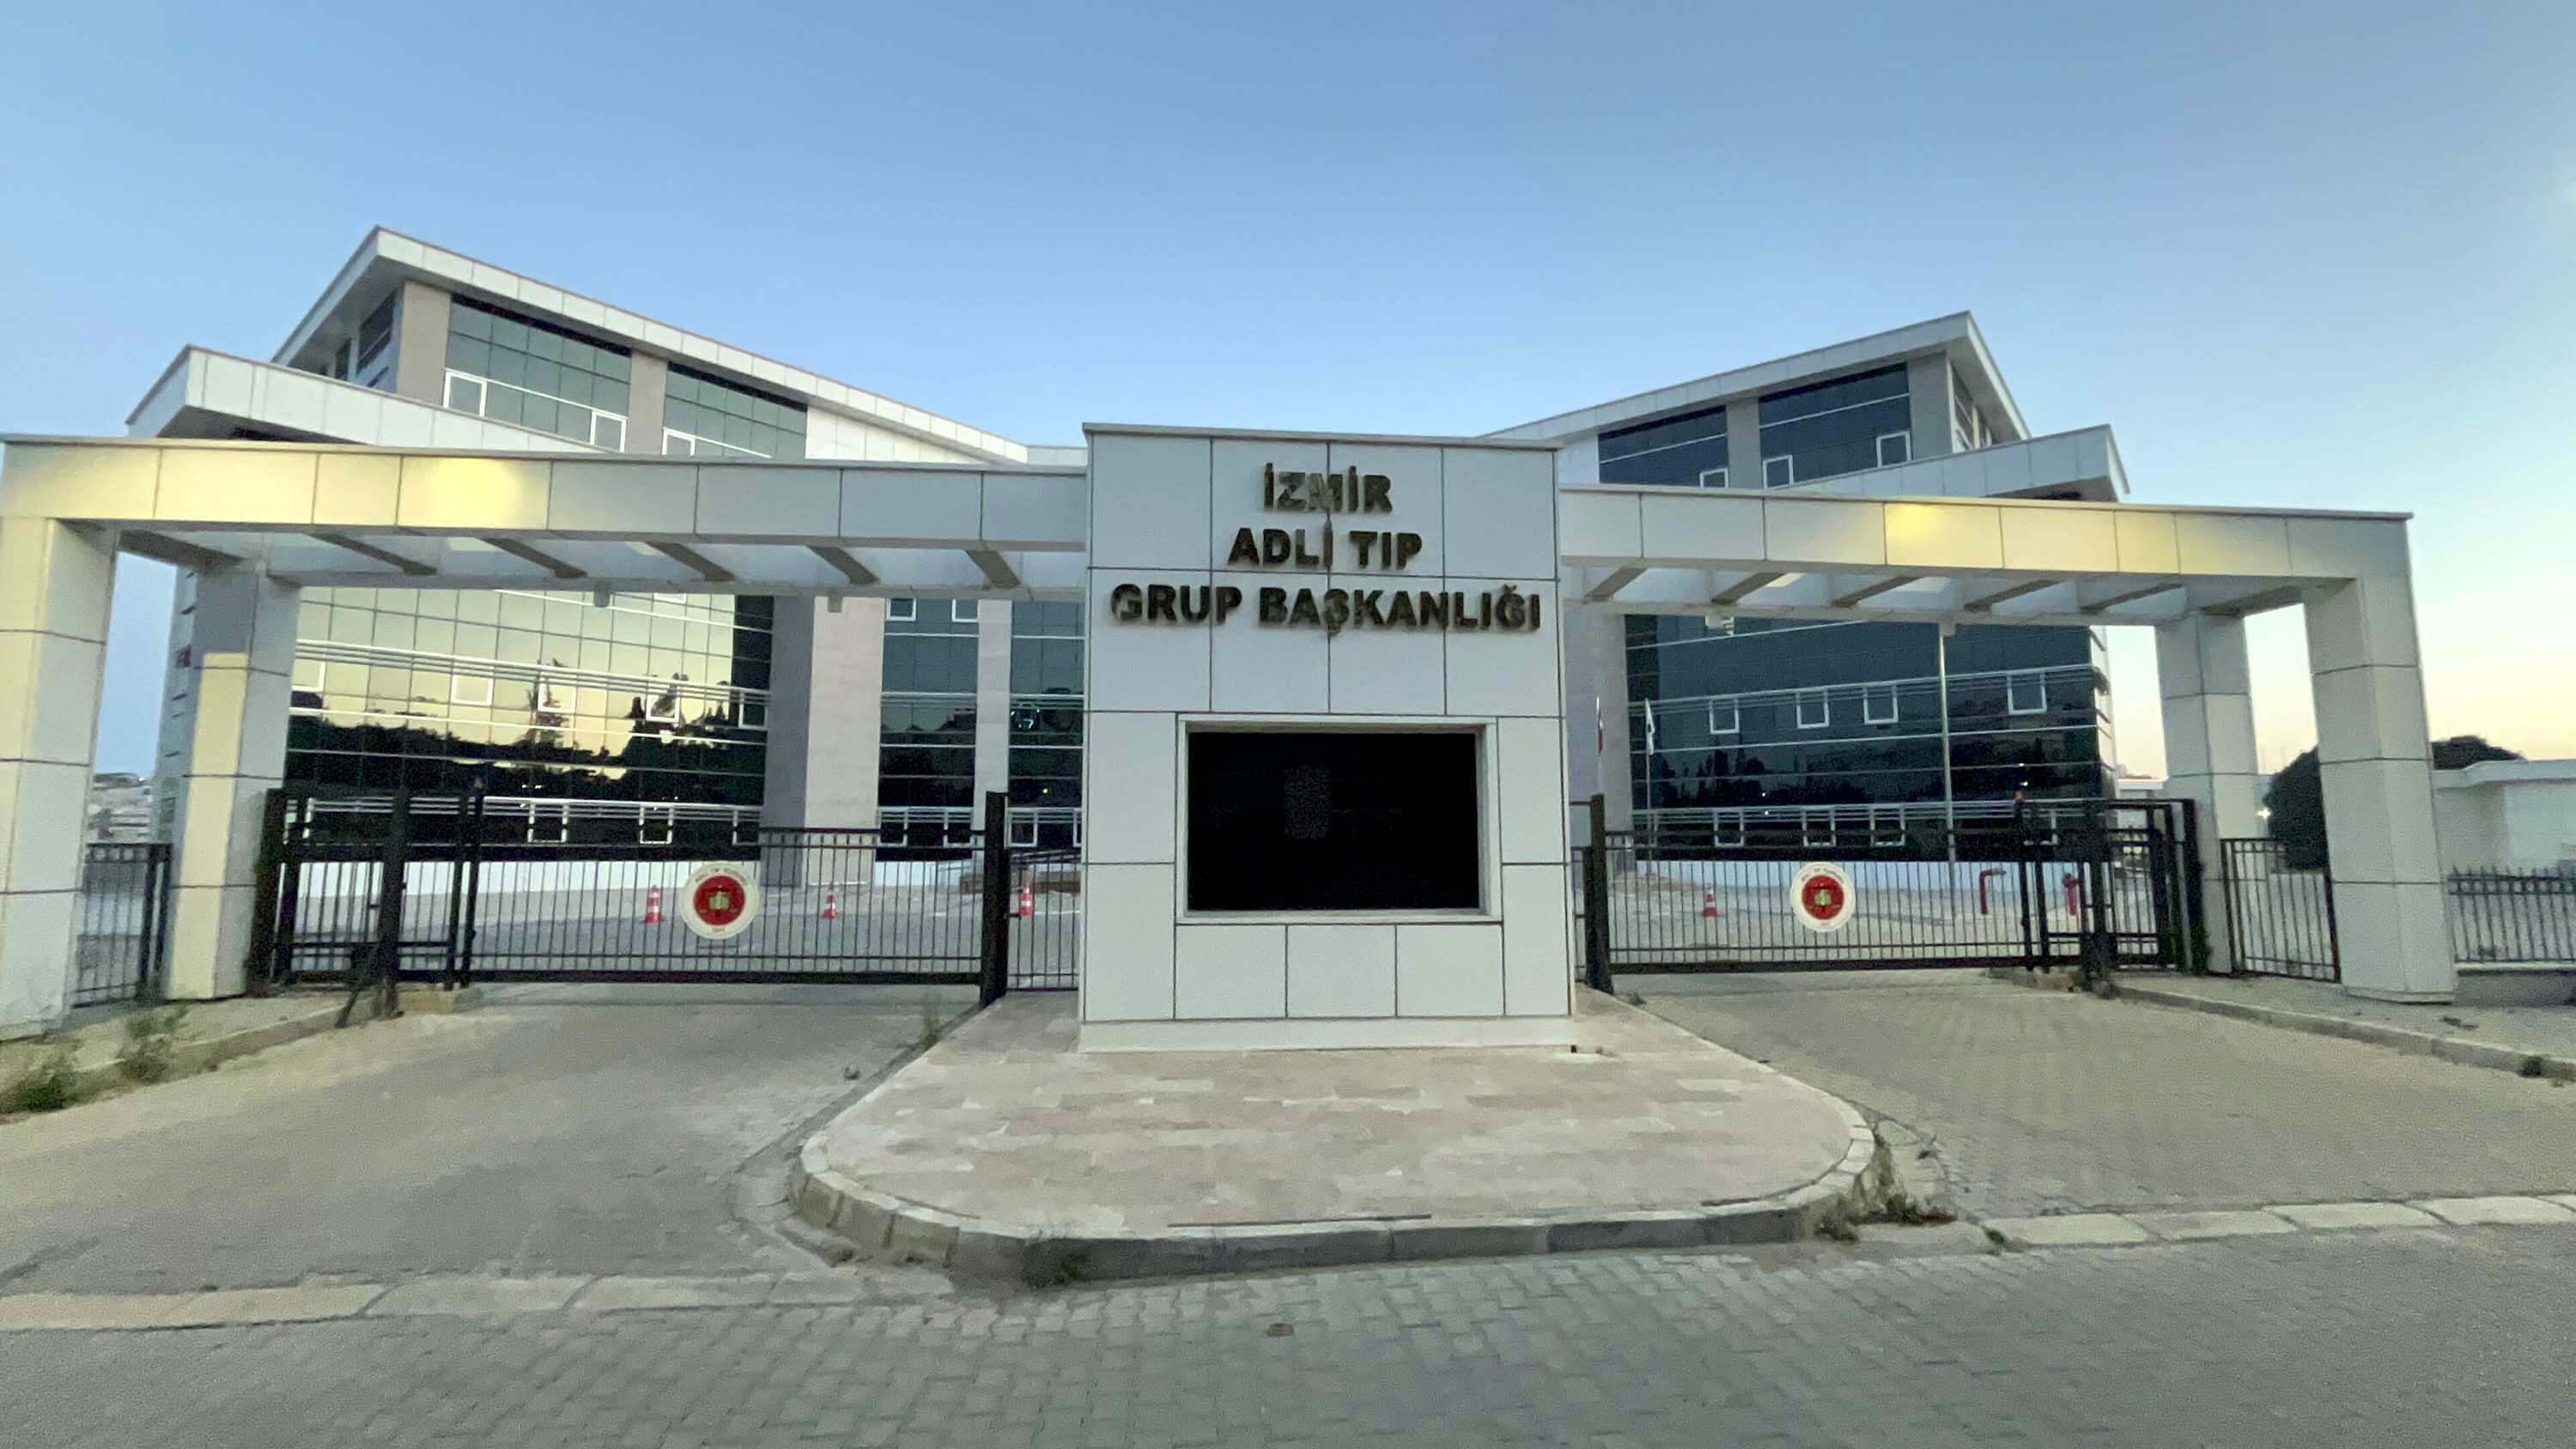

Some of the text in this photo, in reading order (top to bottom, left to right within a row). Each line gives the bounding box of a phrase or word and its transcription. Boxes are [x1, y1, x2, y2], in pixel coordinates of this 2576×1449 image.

[1264, 462, 1393, 512] İZMİR
[1228, 520, 1422, 568] ADLİ TIP
[1111, 583, 1540, 635] GRUP BAŞKANLIĞI
